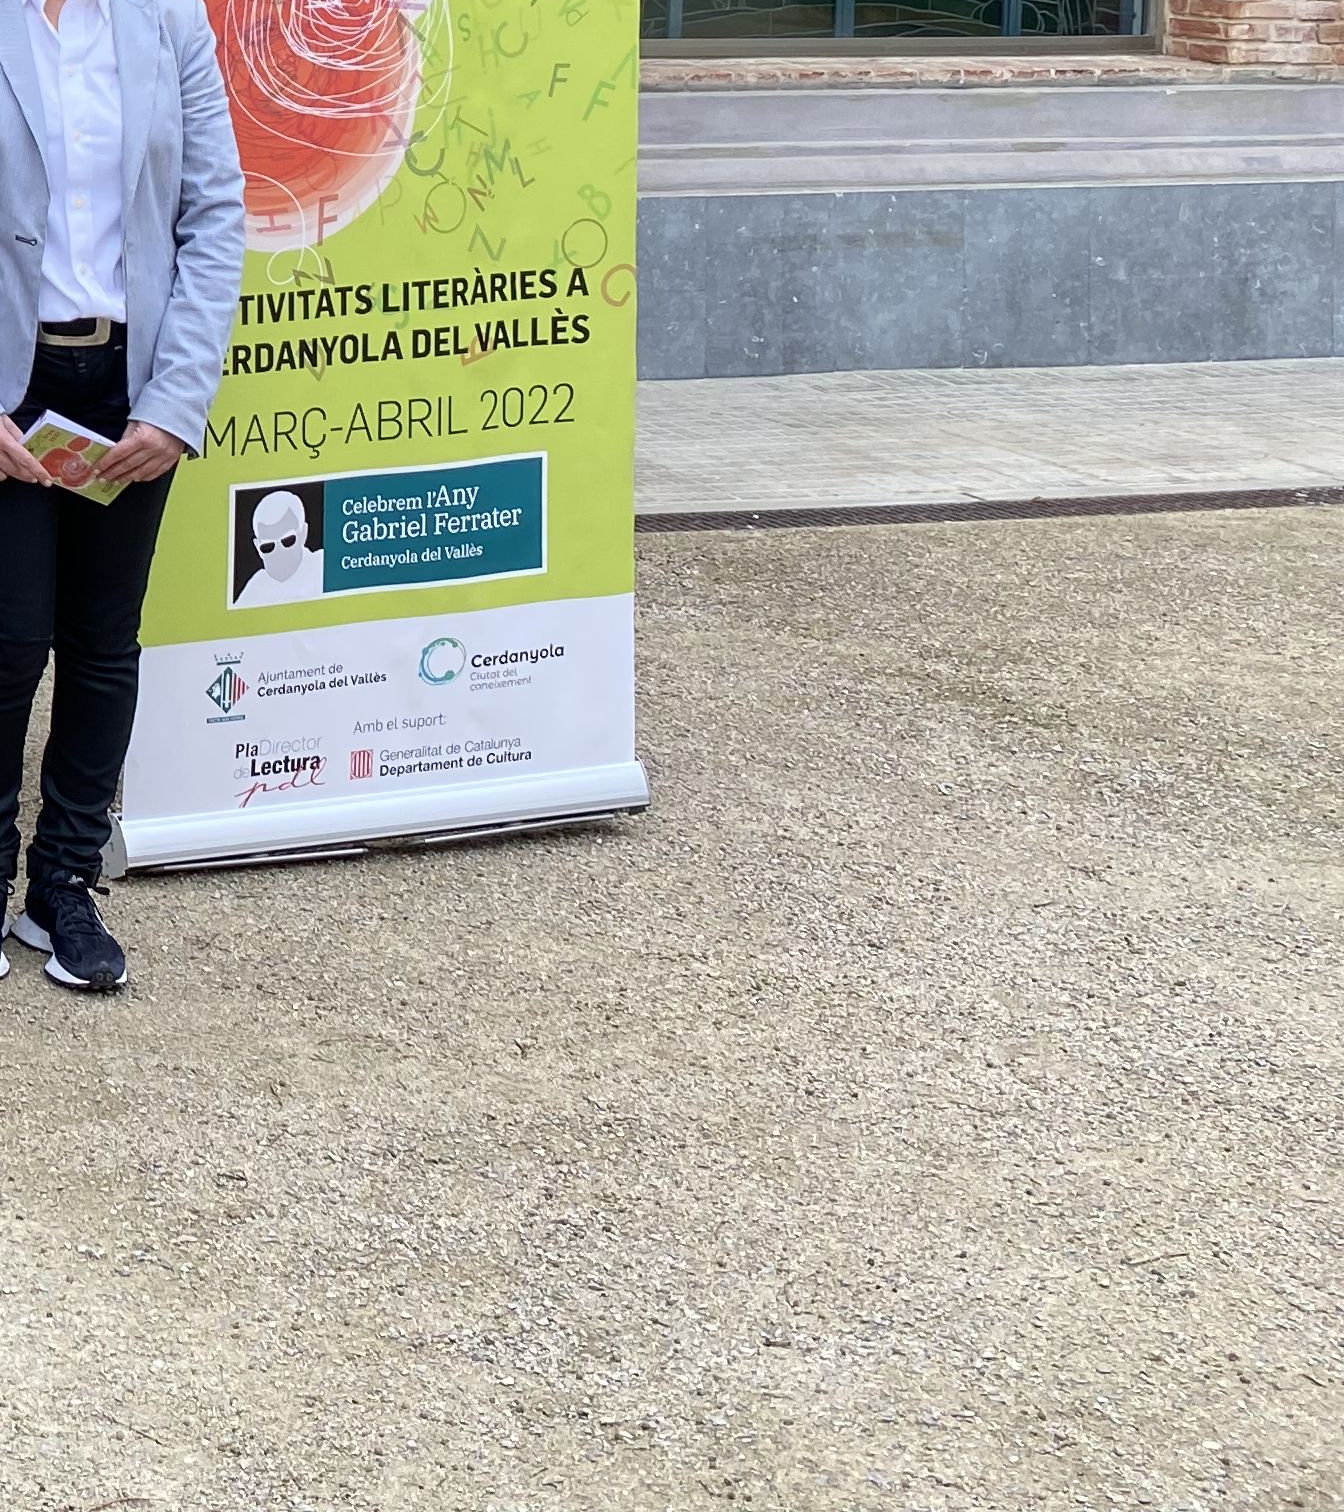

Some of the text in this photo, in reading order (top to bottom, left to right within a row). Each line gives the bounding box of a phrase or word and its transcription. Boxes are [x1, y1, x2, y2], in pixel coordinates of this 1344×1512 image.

[382, 268, 557, 313] LITERÀRIES
[566, 268, 589, 297] A
[412, 325, 468, 359] DEL
[475, 308, 590, 353] VALLÈS
[203, 383, 575, 459] MARÇ-ABRIL 2022
[342, 485, 479, 515] Celebrem l'Any
[342, 507, 522, 544] Gabriel Ferrater
[341, 543, 483, 569] Cerdanyola del Vallès
[471, 643, 564, 668] Cerdanyola
[257, 672, 386, 697] Cerdanyola del Vallès
[258, 663, 343, 683] Ajuntament de
[470, 668, 517, 681] Ciutat del
[353, 719, 383, 734] Amb
[386, 717, 398, 730] el
[380, 736, 521, 762] Generalitat de Catalunya
[380, 749, 532, 777] Departament de Cultura
